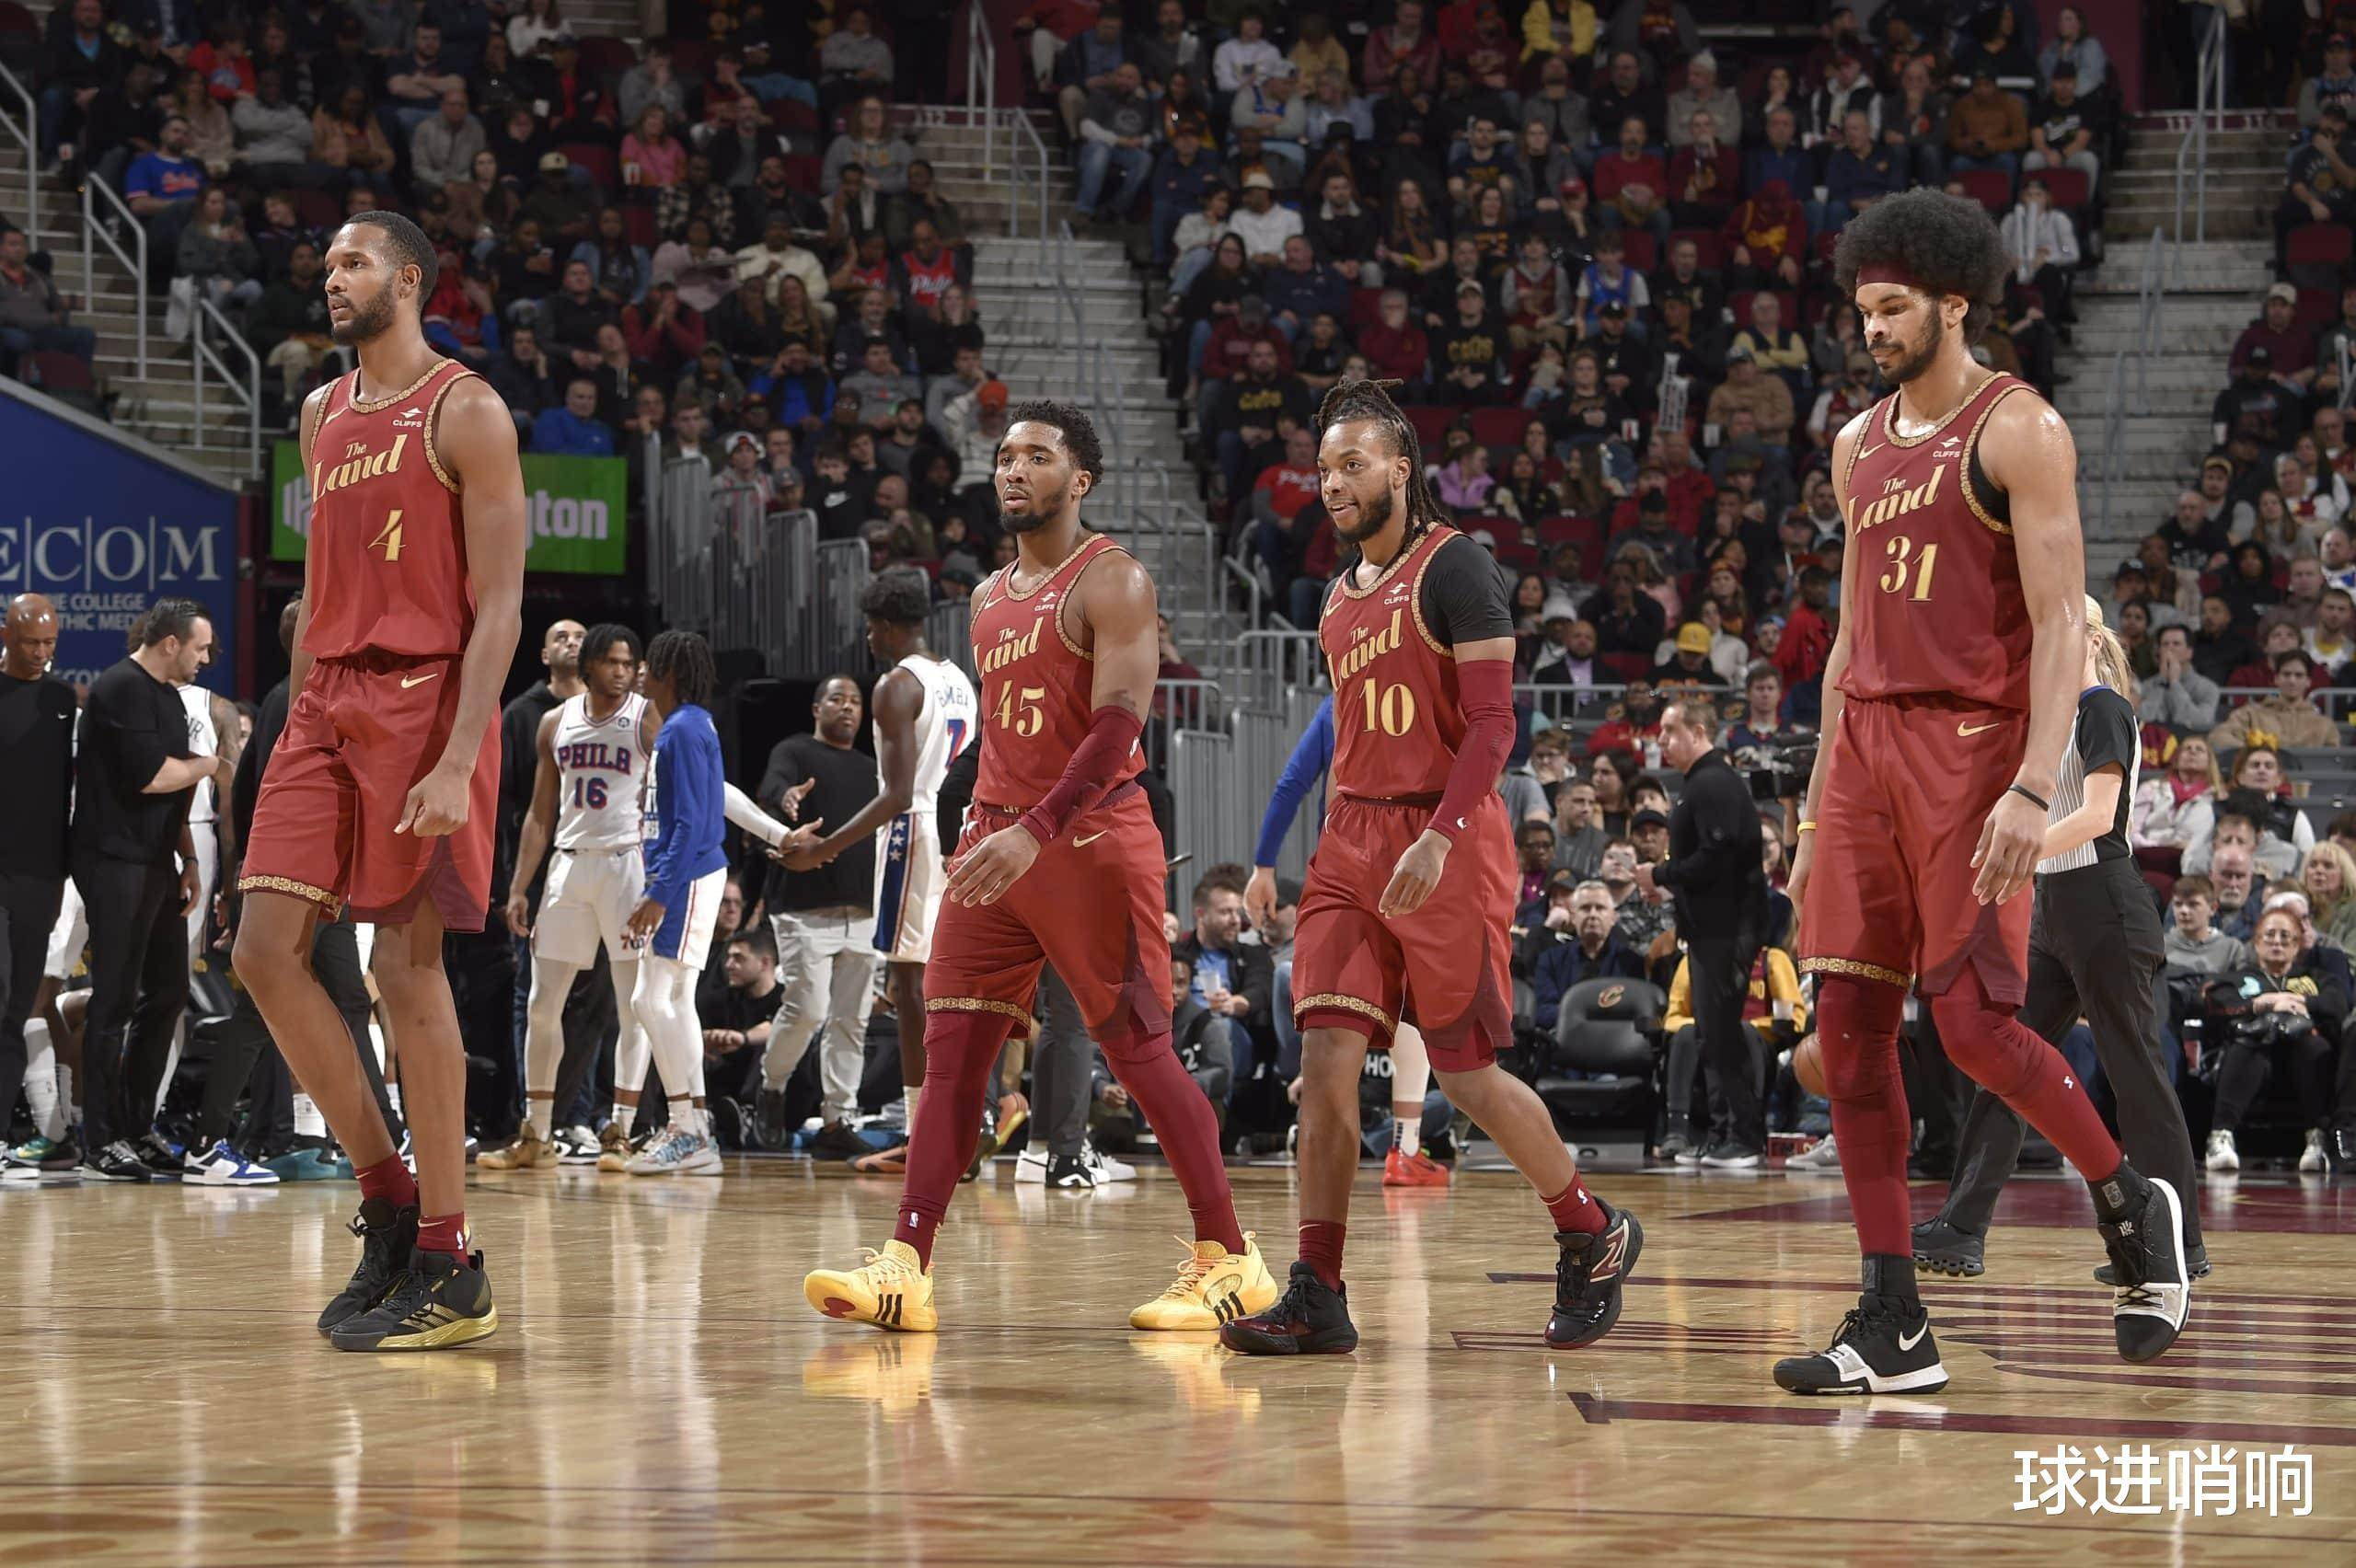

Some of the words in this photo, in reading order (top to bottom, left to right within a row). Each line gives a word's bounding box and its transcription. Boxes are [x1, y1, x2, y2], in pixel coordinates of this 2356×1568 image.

[392, 420, 422, 428] CLIFFS
[345, 441, 367, 459] The
[1932, 450, 1961, 459] CLIFFS
[312, 432, 409, 504] Land
[1847, 463, 1946, 536] Land
[1882, 477, 1906, 495] The
[367, 508, 408, 562] 4
[1878, 535, 1939, 603] 31
[70, 594, 145, 611] COLLEGE
[1034, 603, 1056, 612] CLIFFS
[1383, 594, 1410, 605] CLIFFS
[973, 616, 1045, 679] Land
[998, 627, 1016, 643] The
[1326, 607, 1404, 693] Land
[1350, 626, 1369, 645] The
[990, 679, 1046, 737] 45
[1358, 677, 1415, 737] 10
[557, 743, 632, 776] PHILA
[945, 718, 967, 768] 7
[574, 776, 608, 810] 16
